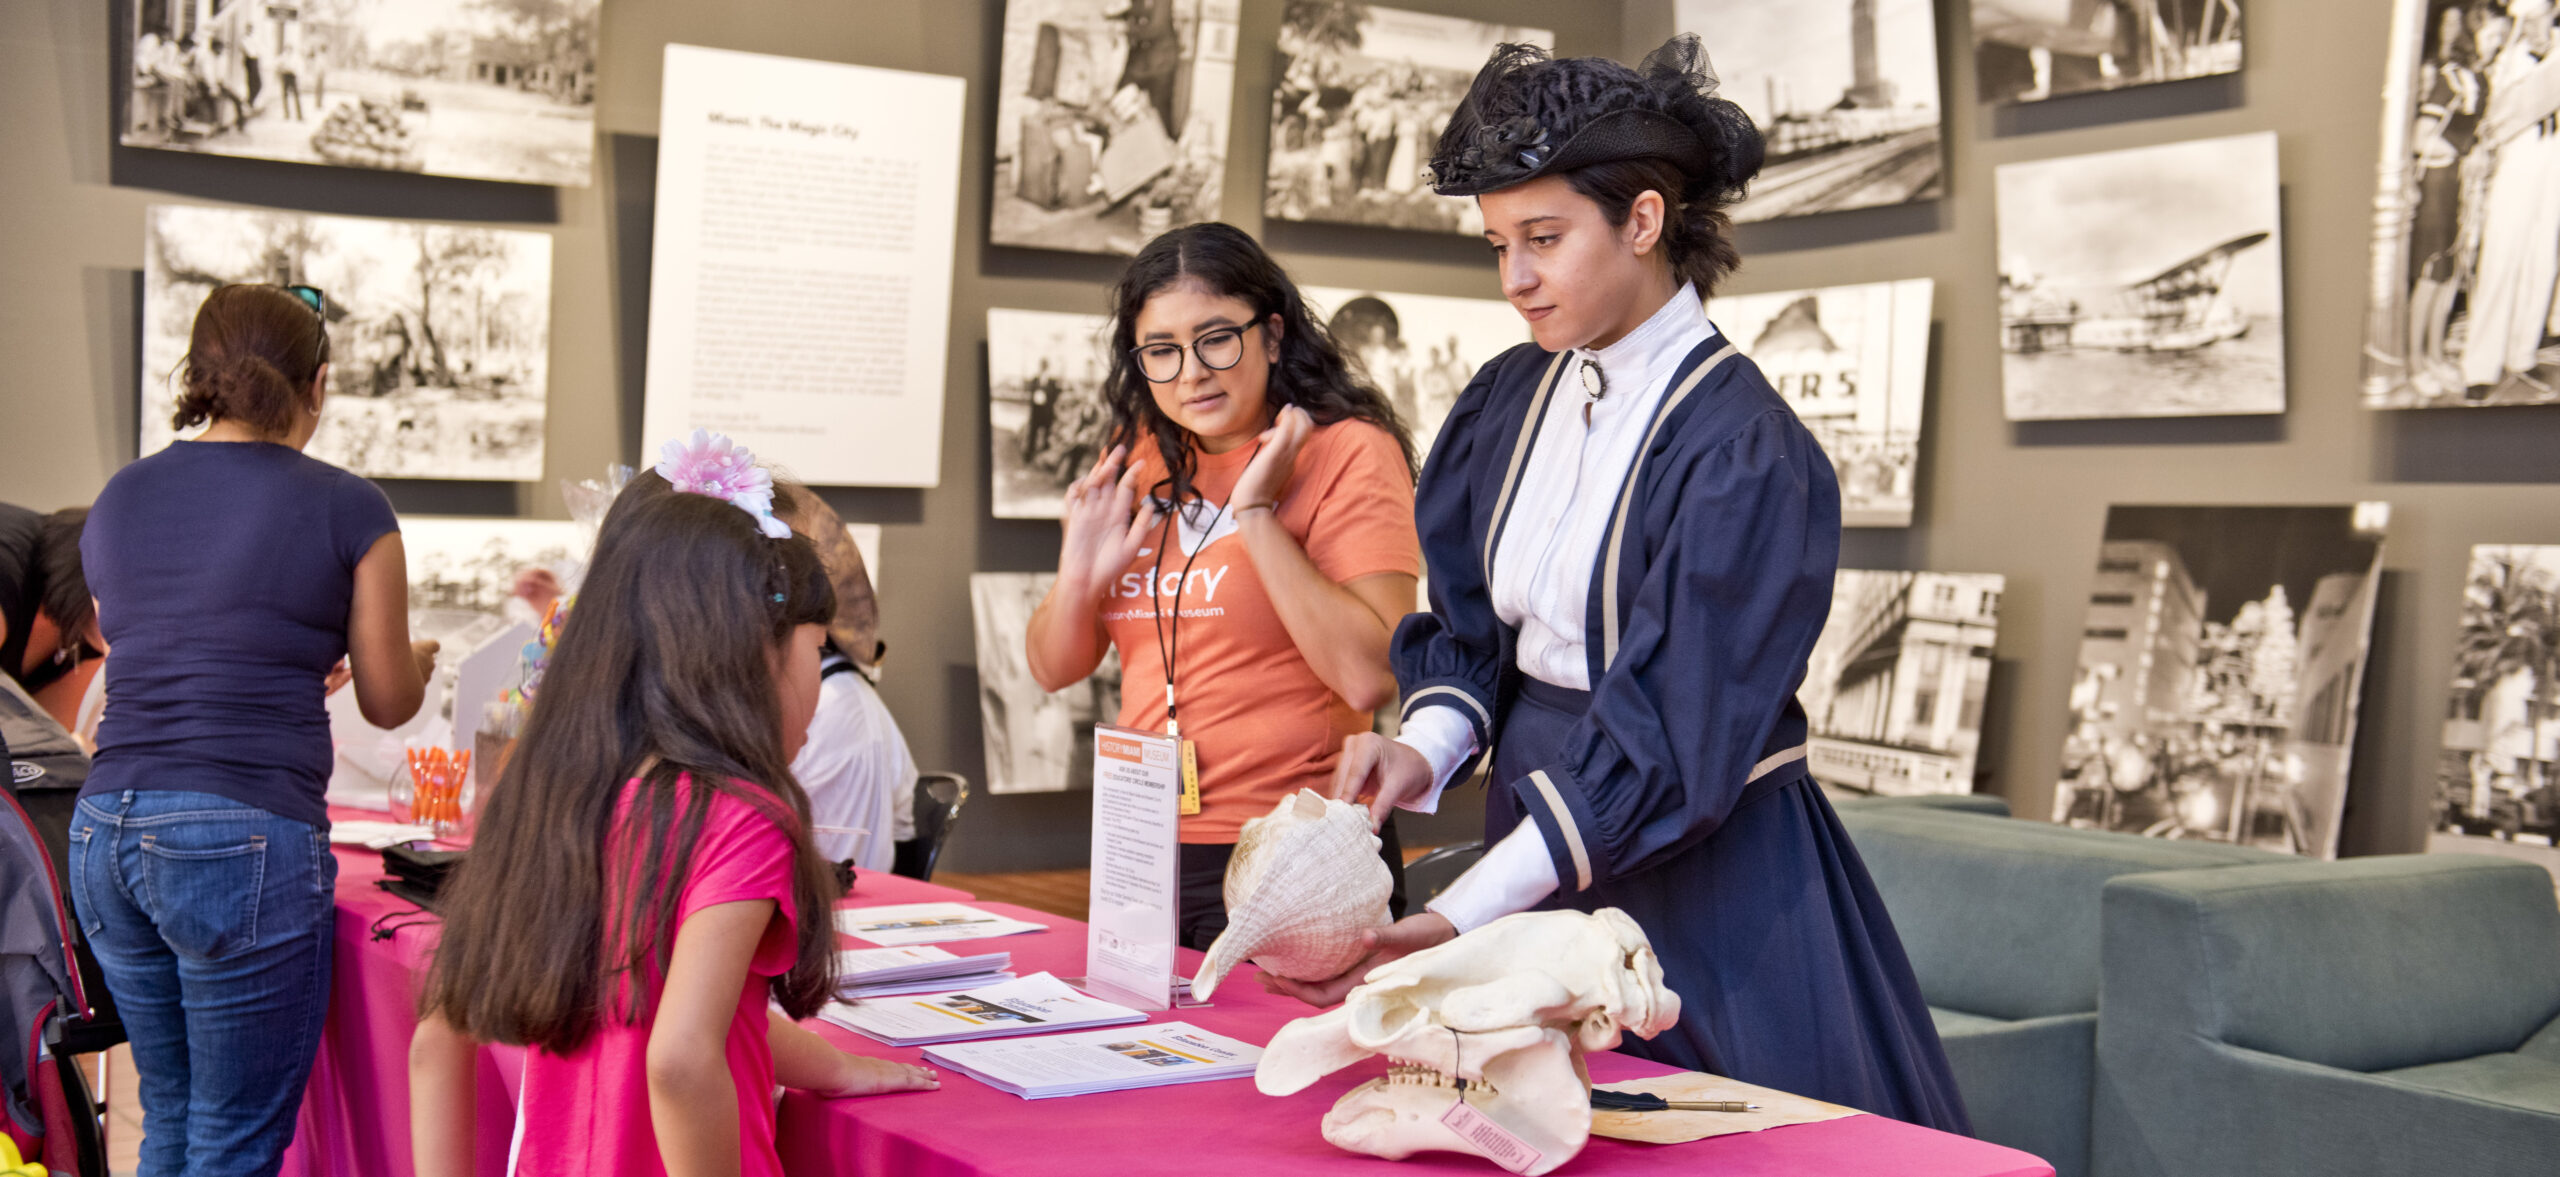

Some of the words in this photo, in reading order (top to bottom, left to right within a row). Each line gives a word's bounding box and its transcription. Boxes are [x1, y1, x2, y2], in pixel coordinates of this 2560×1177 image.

[760, 116, 783, 130] The
[787, 120, 827, 138] Magic
[832, 124, 859, 141] City
[1102, 565, 1229, 602] istory
